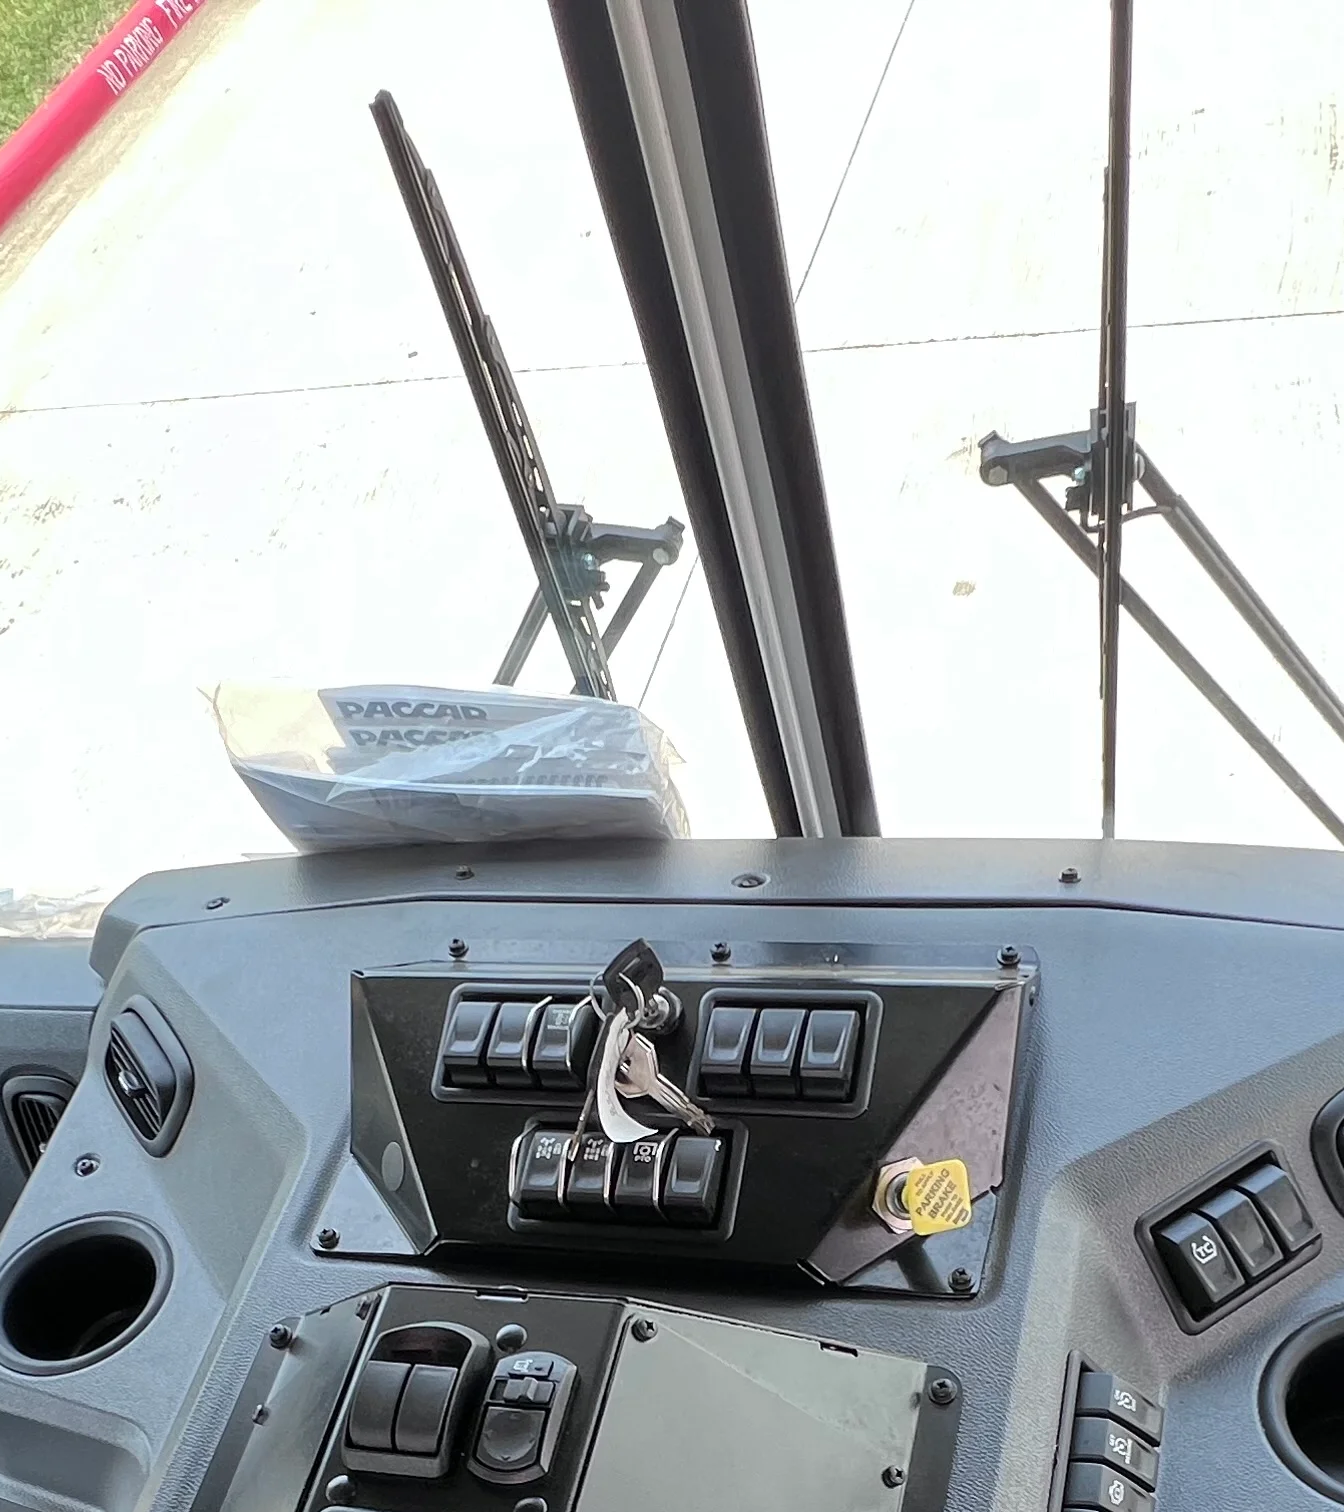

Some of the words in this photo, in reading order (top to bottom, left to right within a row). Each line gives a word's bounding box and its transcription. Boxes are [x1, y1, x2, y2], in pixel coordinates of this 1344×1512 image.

[96, 59, 127, 96] NO
[113, 16, 164, 78] PARKING
[915, 1168, 950, 1217] PARKING
[928, 1180, 957, 1219] BRAKE
